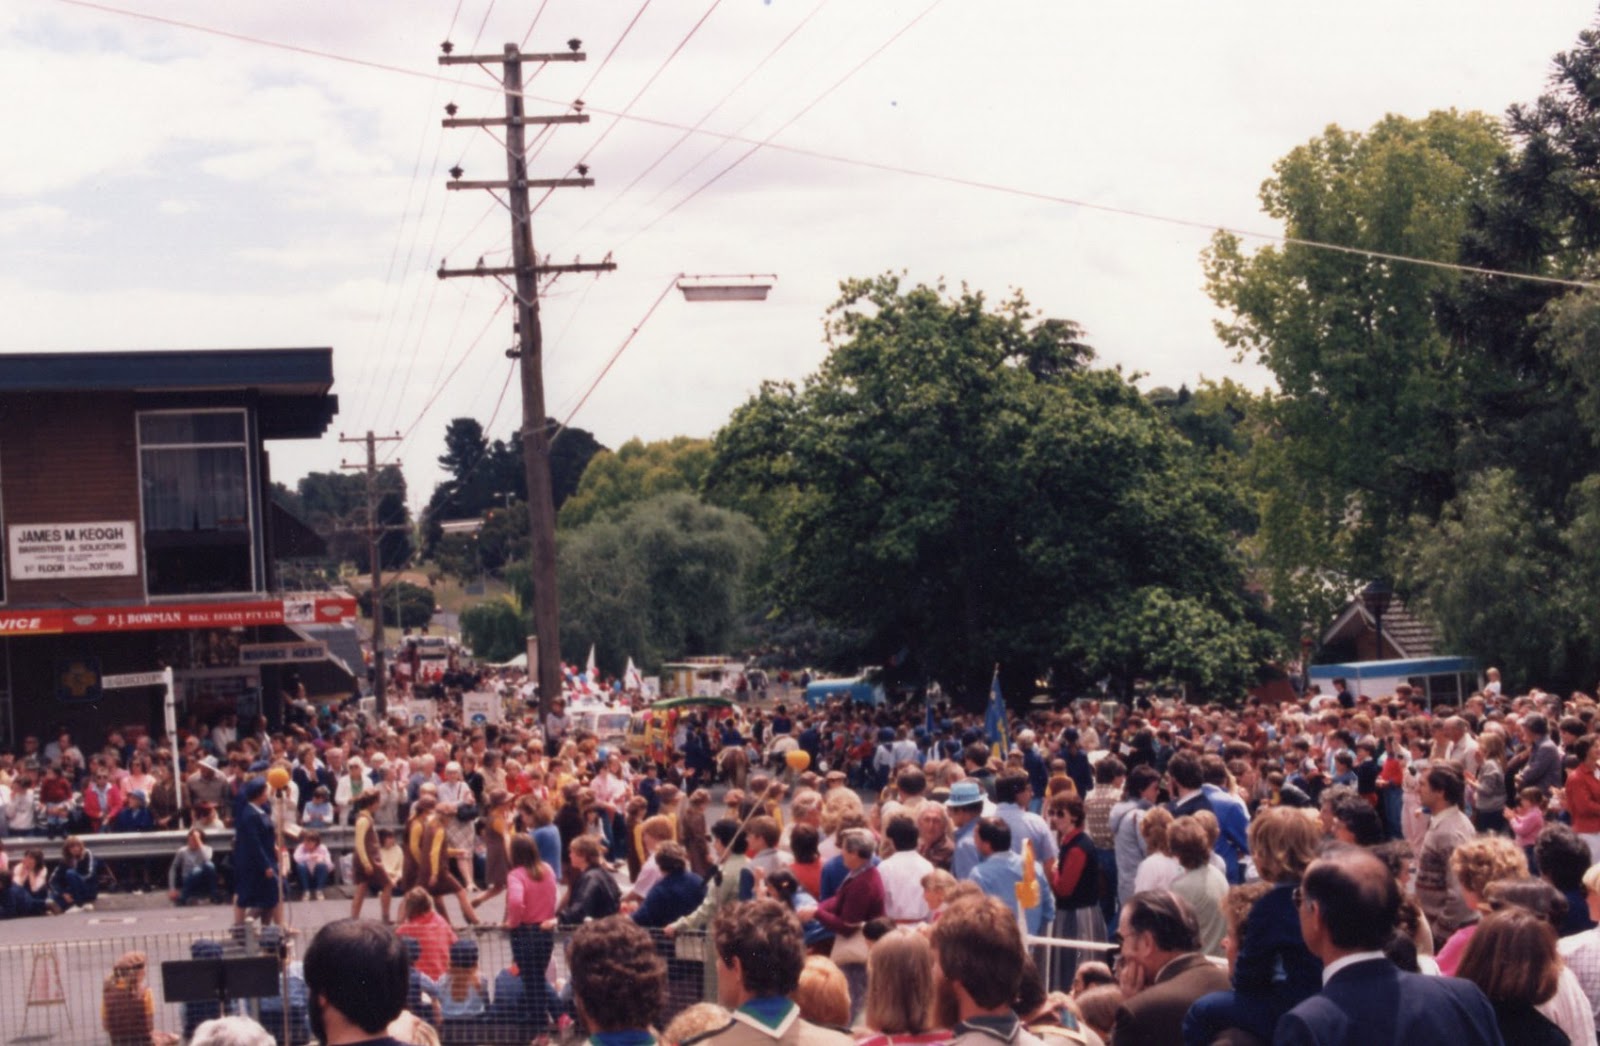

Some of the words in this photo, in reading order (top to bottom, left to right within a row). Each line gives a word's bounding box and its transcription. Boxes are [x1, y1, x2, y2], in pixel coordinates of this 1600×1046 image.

[18, 529, 61, 542] JAMES
[80, 527, 124, 540] KEOGH
[79, 542, 126, 552] SOLICITORS
[38, 563, 65, 572] FLOOR
[127, 611, 181, 624] BOWMAN
[188, 613, 209, 621] REAL
[213, 611, 242, 620] ESTATE
